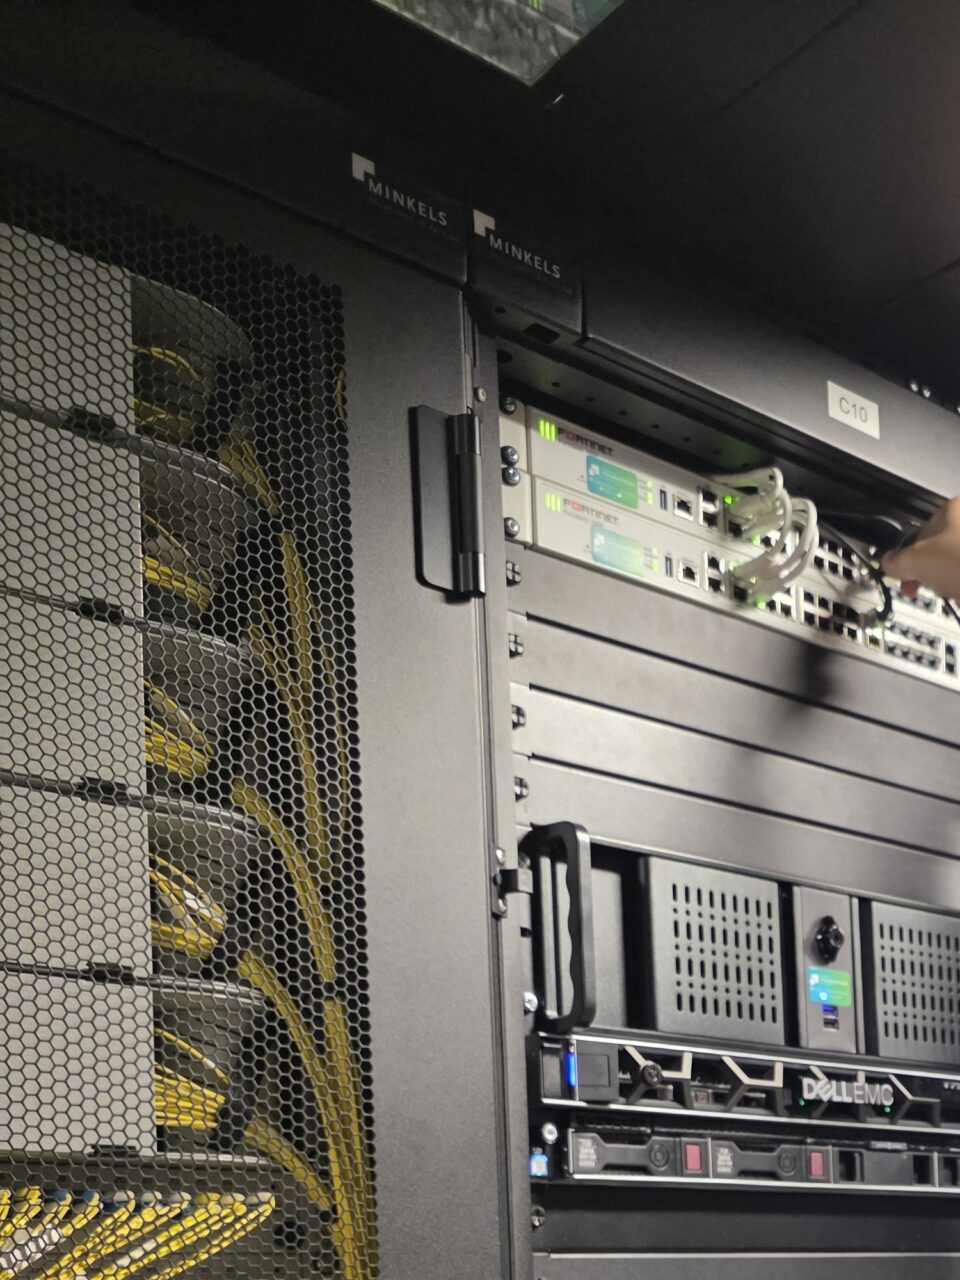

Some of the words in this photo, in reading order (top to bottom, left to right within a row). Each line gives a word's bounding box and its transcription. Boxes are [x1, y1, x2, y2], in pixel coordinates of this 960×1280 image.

[368, 178, 448, 226] MINKELS
[489, 233, 561, 279] MINKELS
[839, 396, 868, 423] C10
[558, 427, 613, 456] FORTINET
[564, 498, 619, 525] FORTINET
